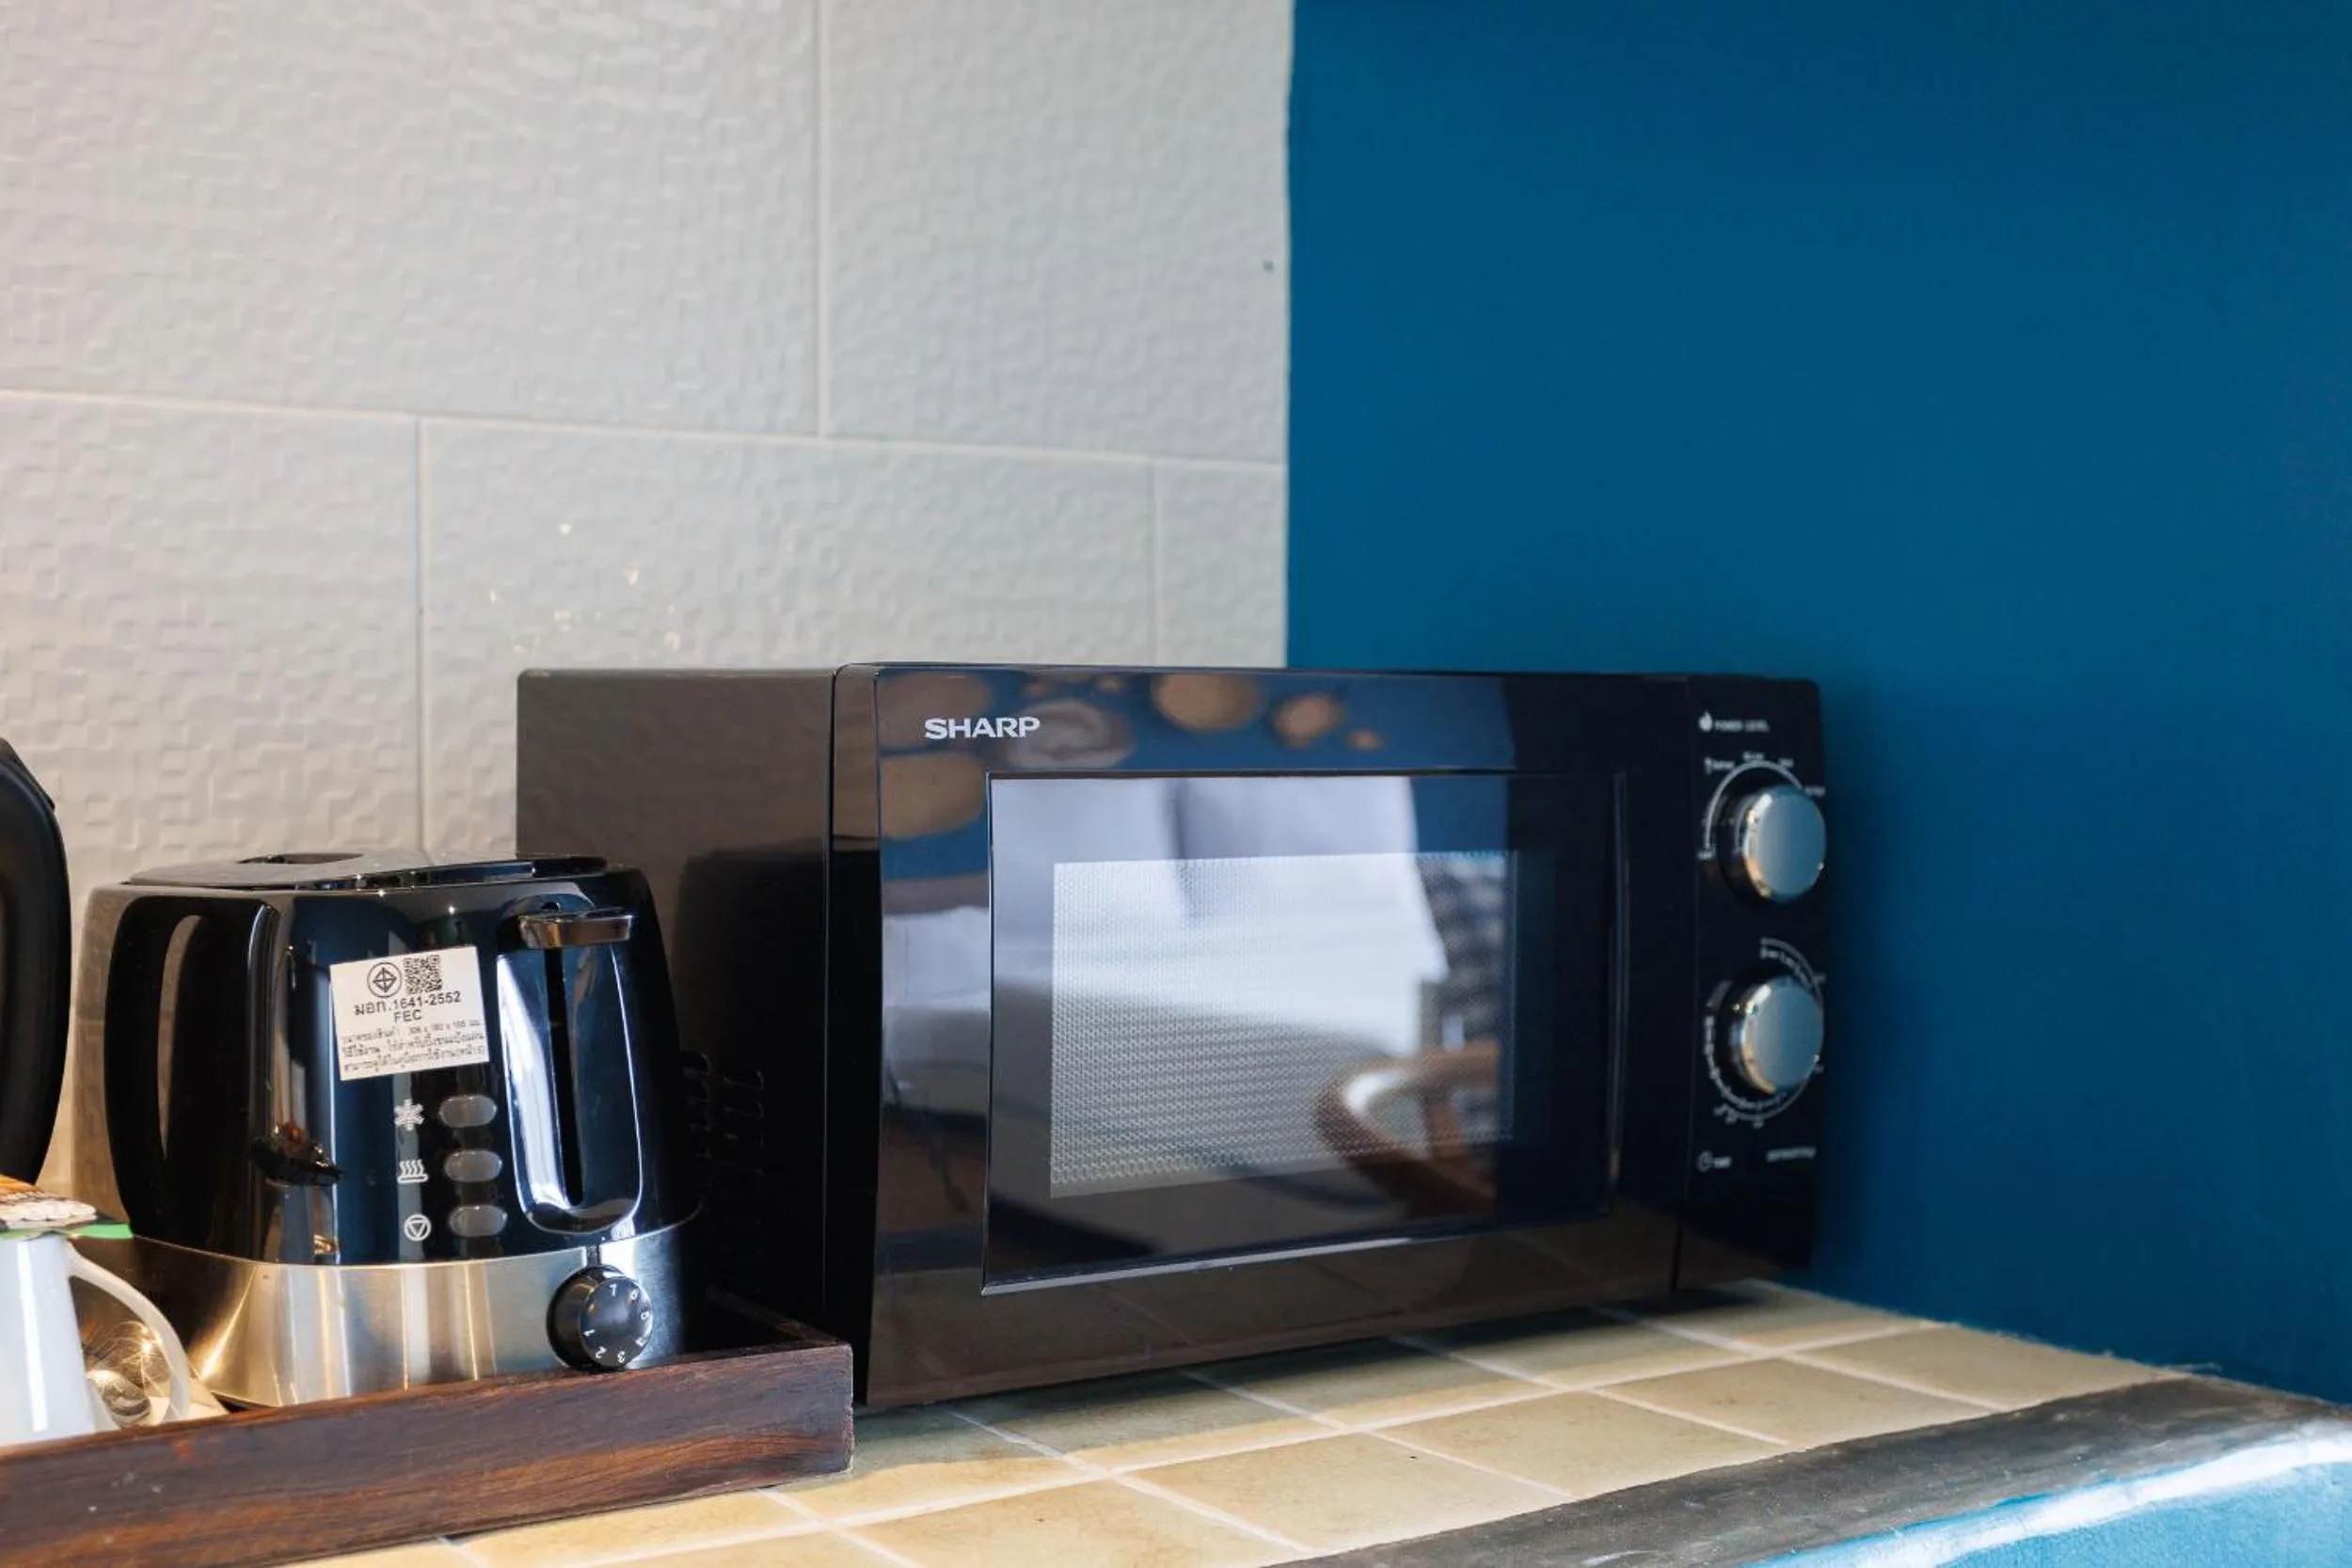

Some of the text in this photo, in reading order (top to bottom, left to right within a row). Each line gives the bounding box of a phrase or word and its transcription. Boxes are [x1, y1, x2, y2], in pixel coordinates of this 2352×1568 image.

[924, 716, 1041, 739] SHARP
[393, 1009, 422, 1024] FEC
[609, 1283, 617, 1297] 7
[596, 1346, 607, 1358] 2
[617, 1350, 626, 1363] 3
